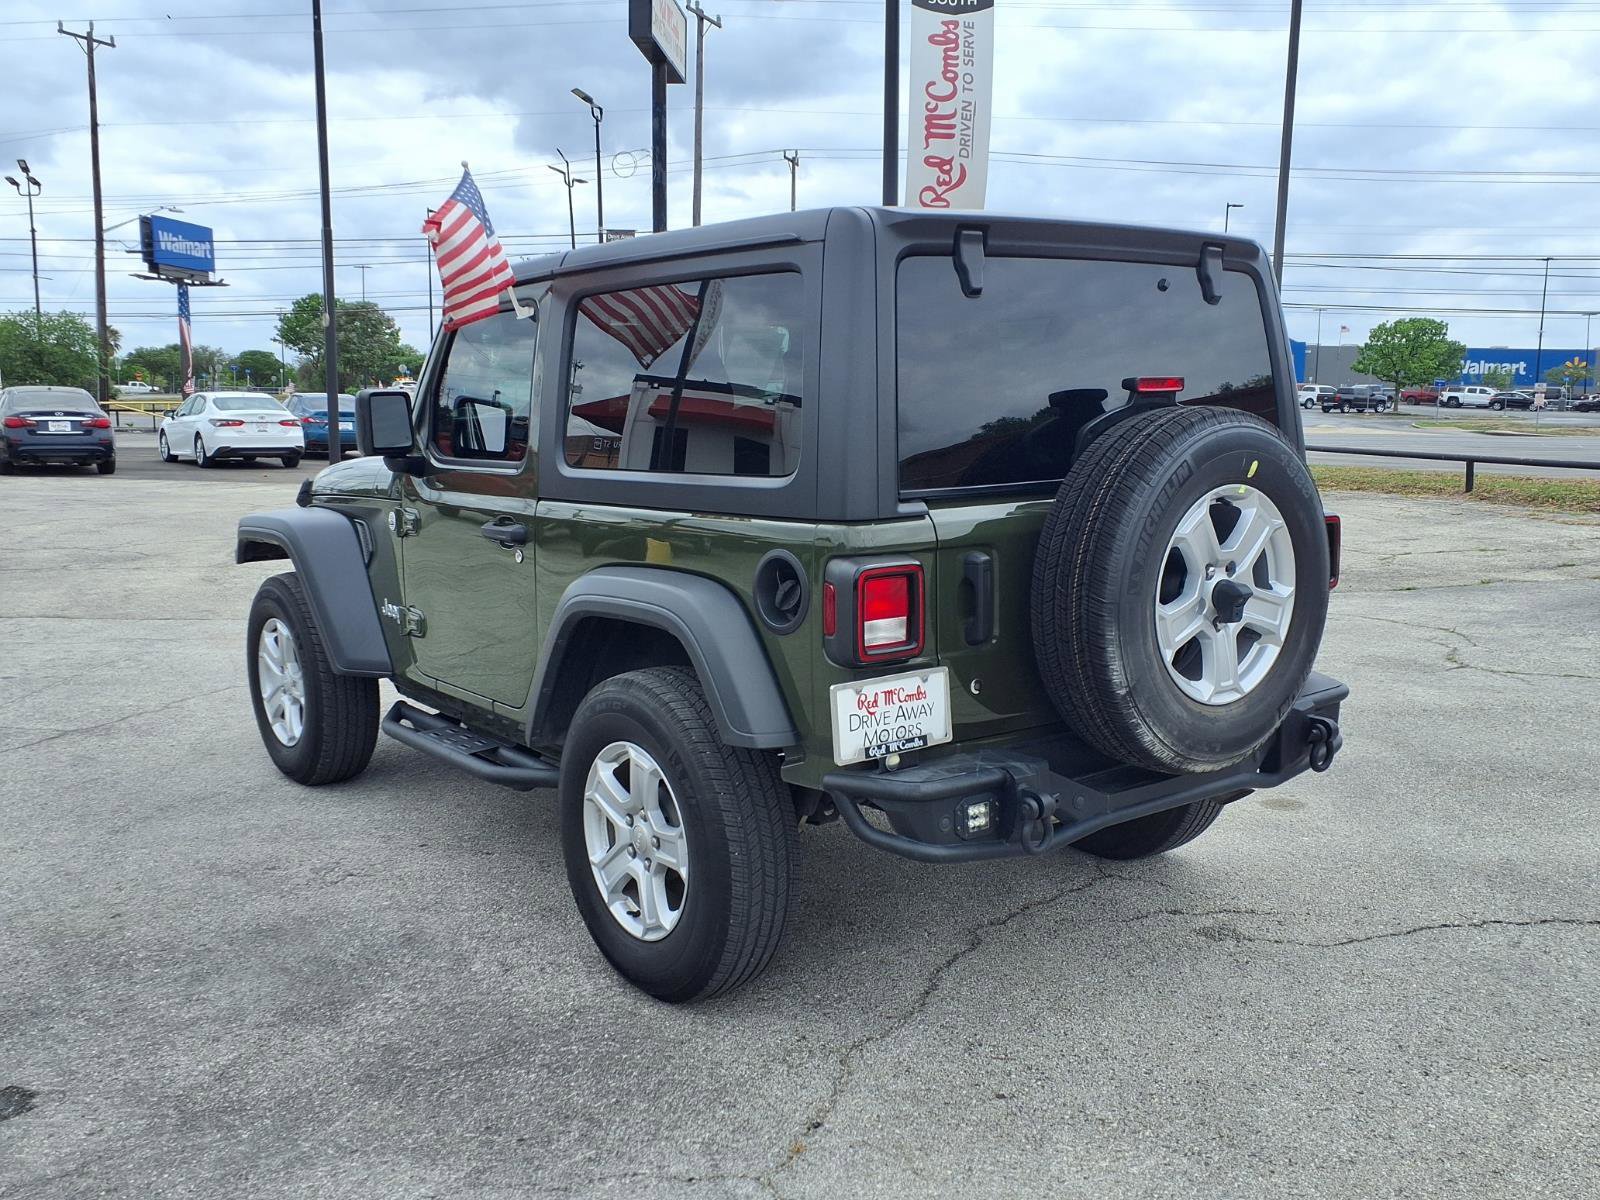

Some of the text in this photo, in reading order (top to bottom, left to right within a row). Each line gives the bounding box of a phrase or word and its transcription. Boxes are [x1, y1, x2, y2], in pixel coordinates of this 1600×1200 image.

[959, 21, 975, 158] DRIVEN TO SERVE
[918, 19, 967, 209] Red McCombs
[158, 231, 211, 258] Walmart
[857, 684, 927, 716] Red McCombs
[849, 701, 935, 732] DRIVE AWAY
[864, 722, 922, 747] MOTORS
[869, 745, 886, 757] Red
